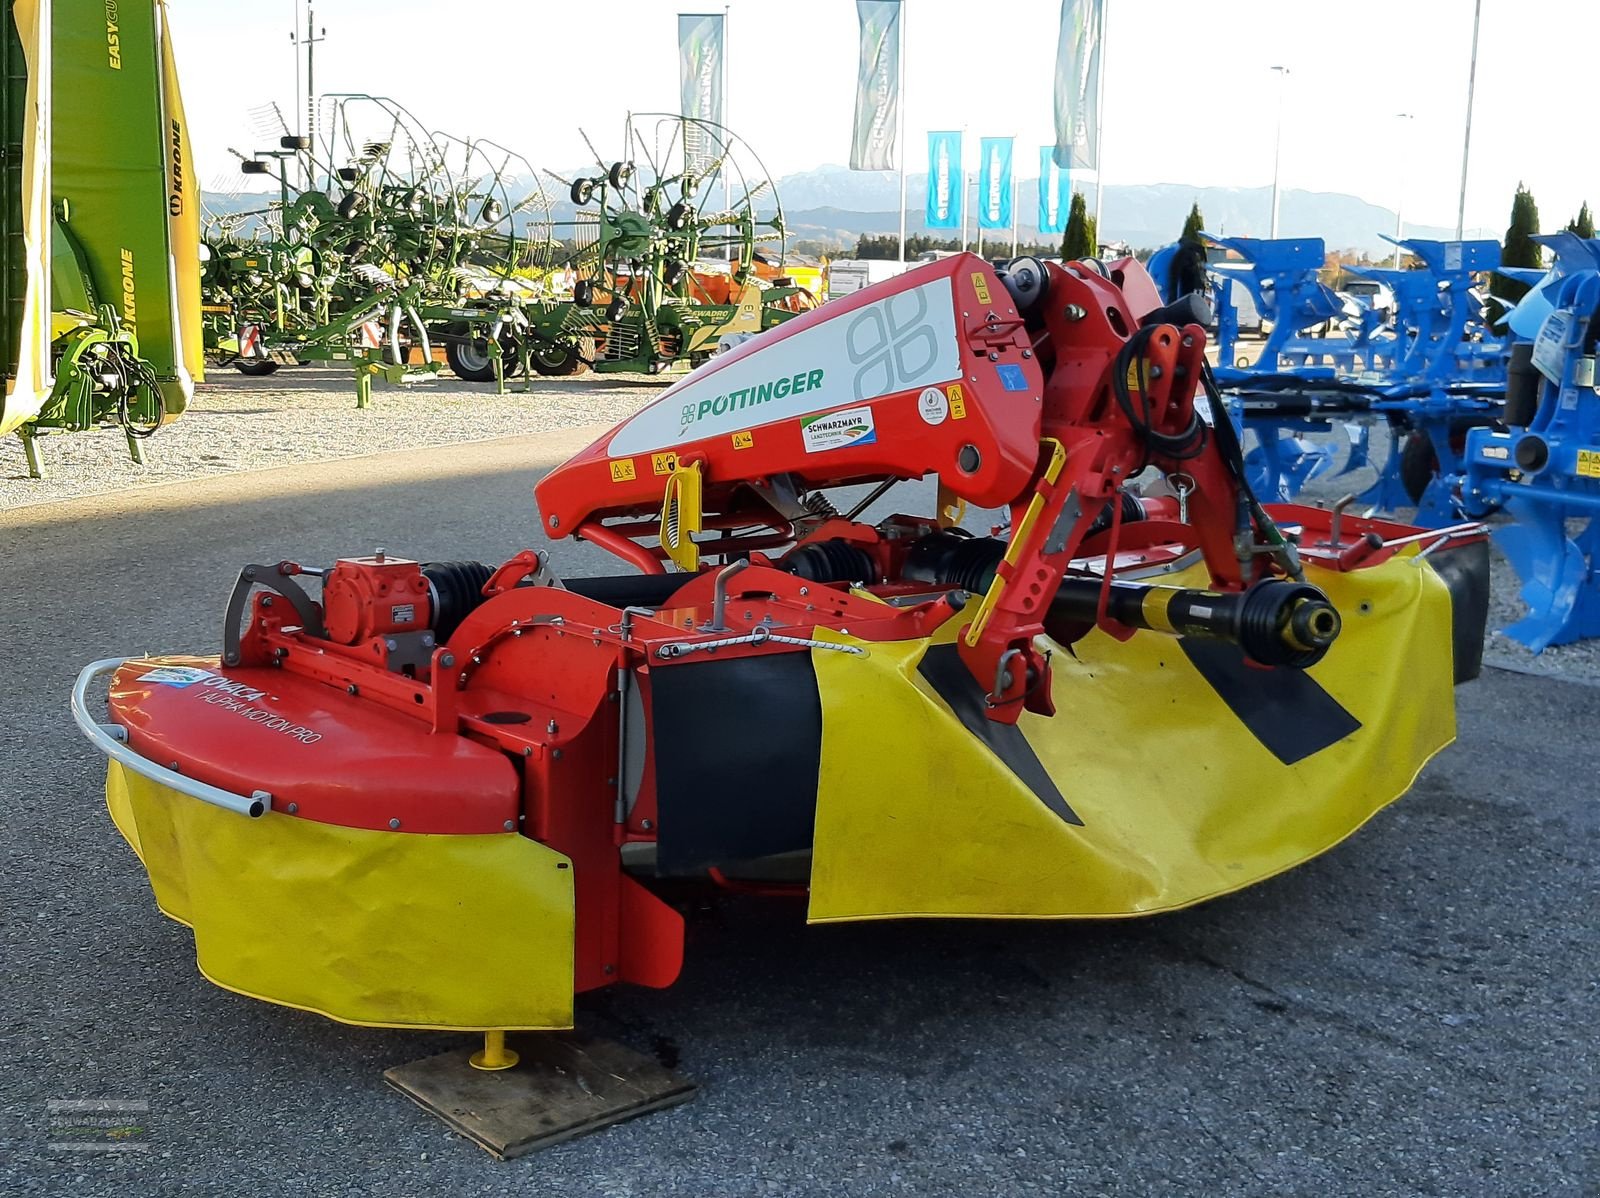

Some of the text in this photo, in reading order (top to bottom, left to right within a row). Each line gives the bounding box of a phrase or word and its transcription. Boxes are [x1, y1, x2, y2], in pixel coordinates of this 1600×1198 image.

[172, 119, 182, 193] KRONE
[121, 248, 136, 322] KRONE
[697, 368, 824, 420] PÖTTINGER
[808, 417, 863, 432] SCHWARZMAYR
[198, 692, 246, 712] ALPHA
[238, 707, 295, 731] MOTION
[284, 726, 322, 744] PRO
